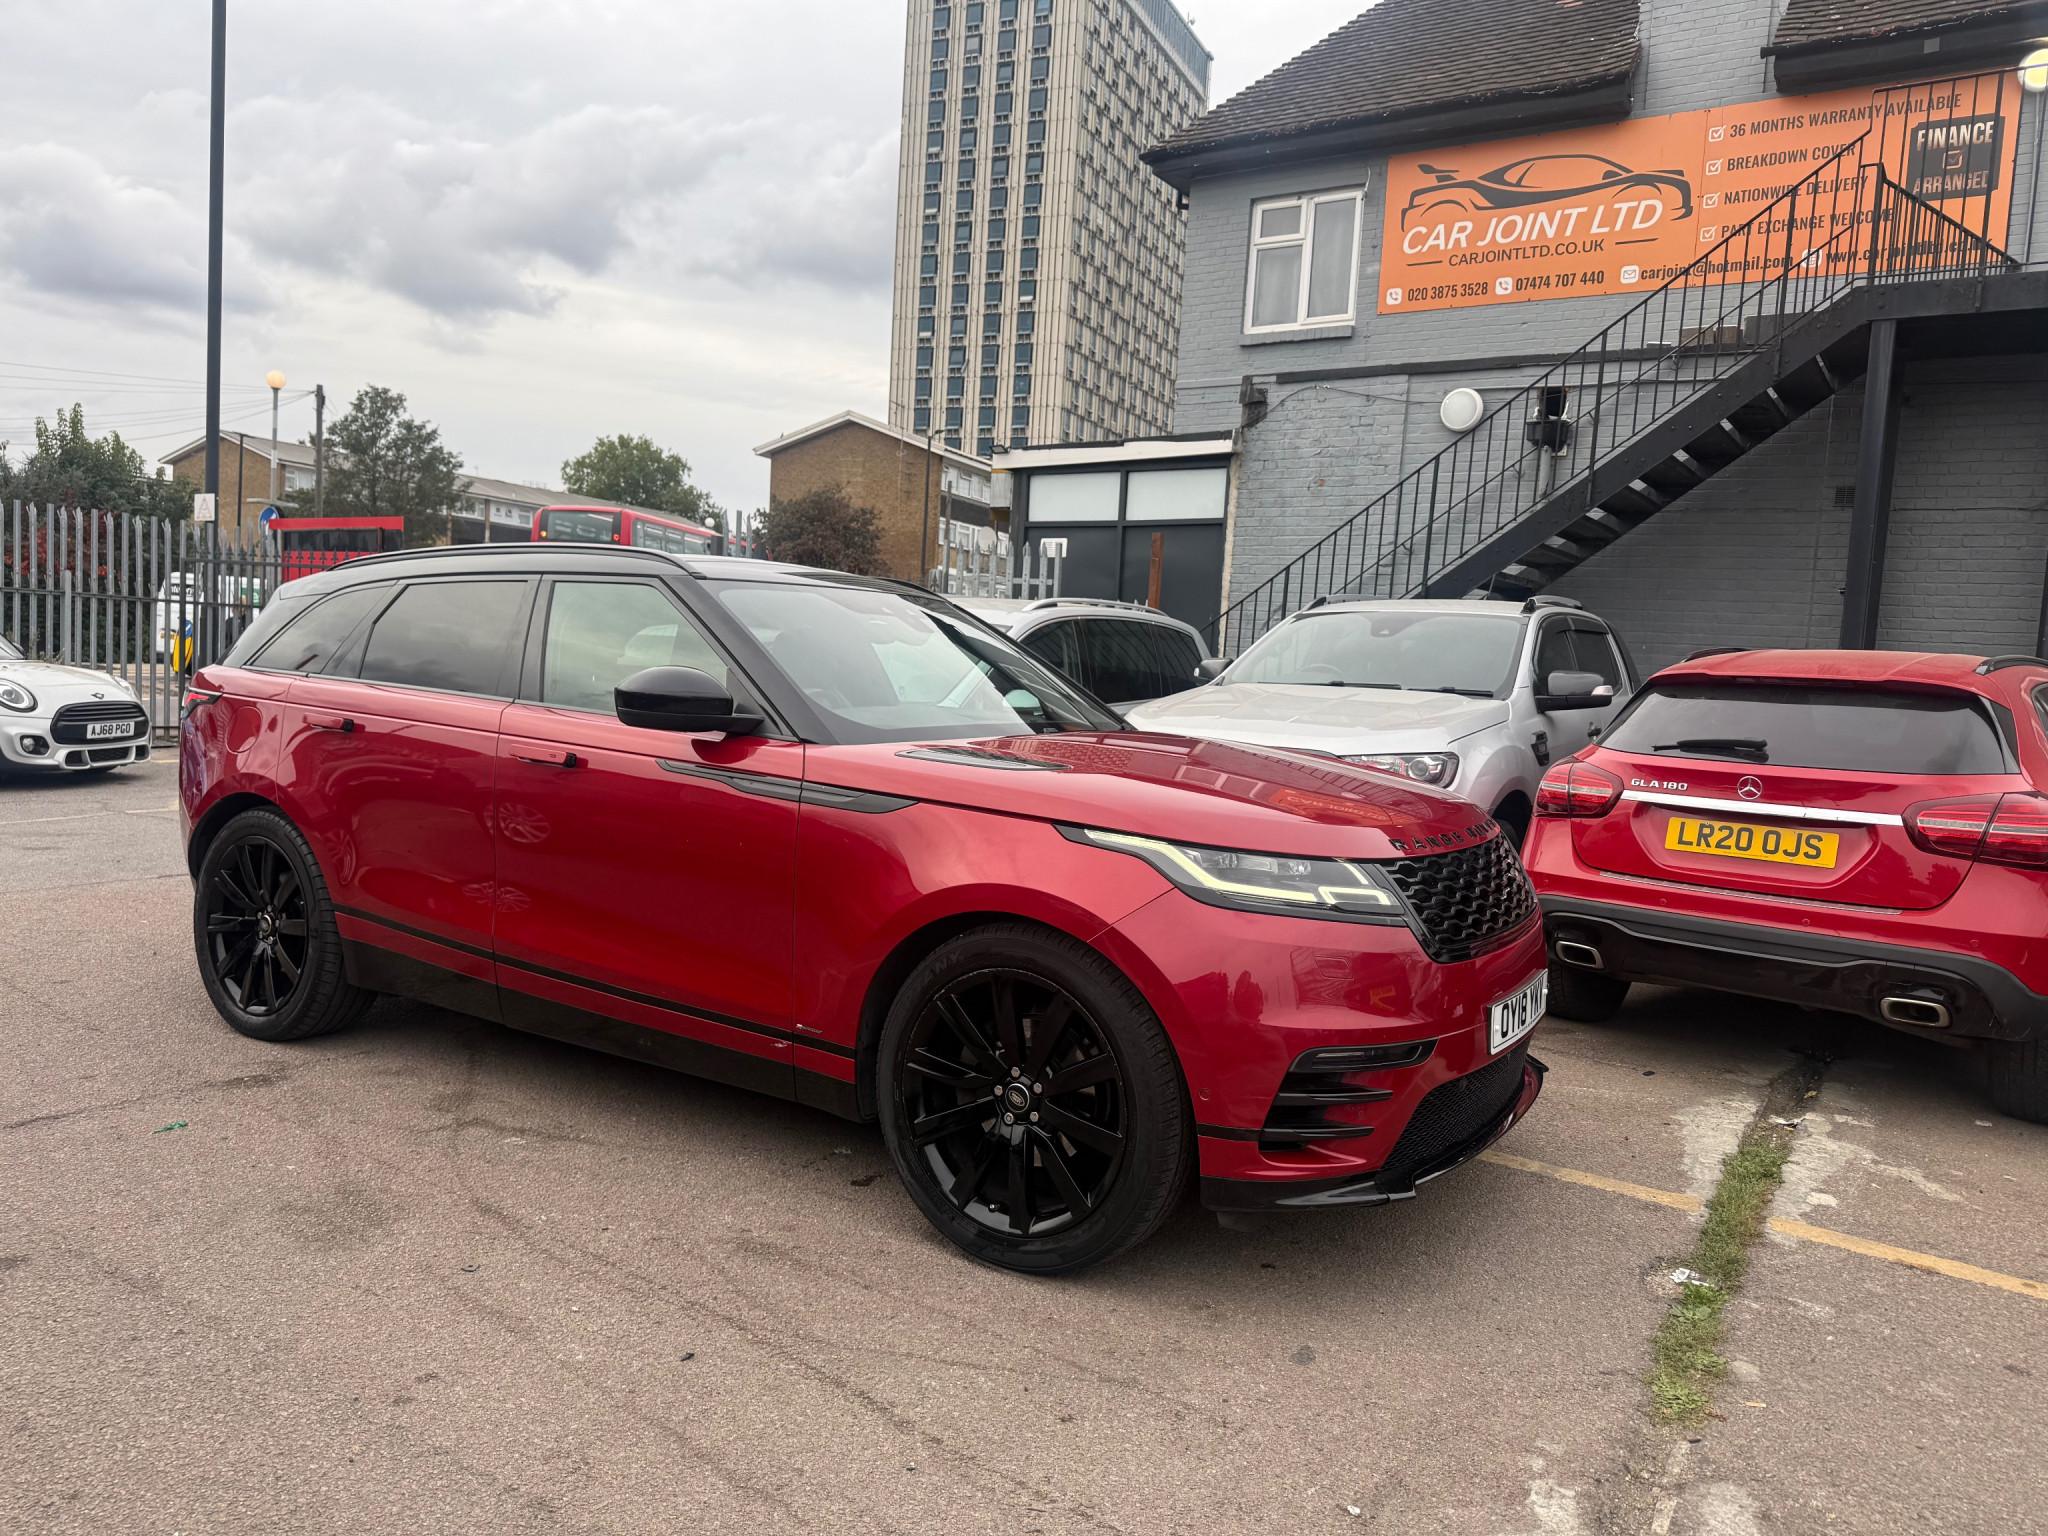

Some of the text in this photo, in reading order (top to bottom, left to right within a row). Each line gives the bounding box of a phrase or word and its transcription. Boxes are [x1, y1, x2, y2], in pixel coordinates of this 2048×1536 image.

[1729, 93, 1962, 138] 36 MONTHS WARRANTY AVAILABLE
[1917, 121, 1994, 151] FINANCE
[1726, 143, 1855, 171] BREAKDOWN COVER
[1723, 175, 1868, 205] NATIONWIDE DELIVERY
[1402, 199, 1663, 255] CAR JOINT LTD
[1721, 222, 1752, 239] PART
[1757, 214, 1825, 235] EXCHANGE
[1448, 238, 1605, 267] CARJOINTLTD.CO.UK
[1407, 281, 1488, 302] 020 3875 3528
[1515, 270, 1605, 291] 07474 707 440
[91, 723, 131, 736] AJ68 PGO
[1631, 778, 1688, 791] GLA 180
[1677, 821, 1824, 860] LR20 OJS
[1501, 992, 1527, 1039] OY18
